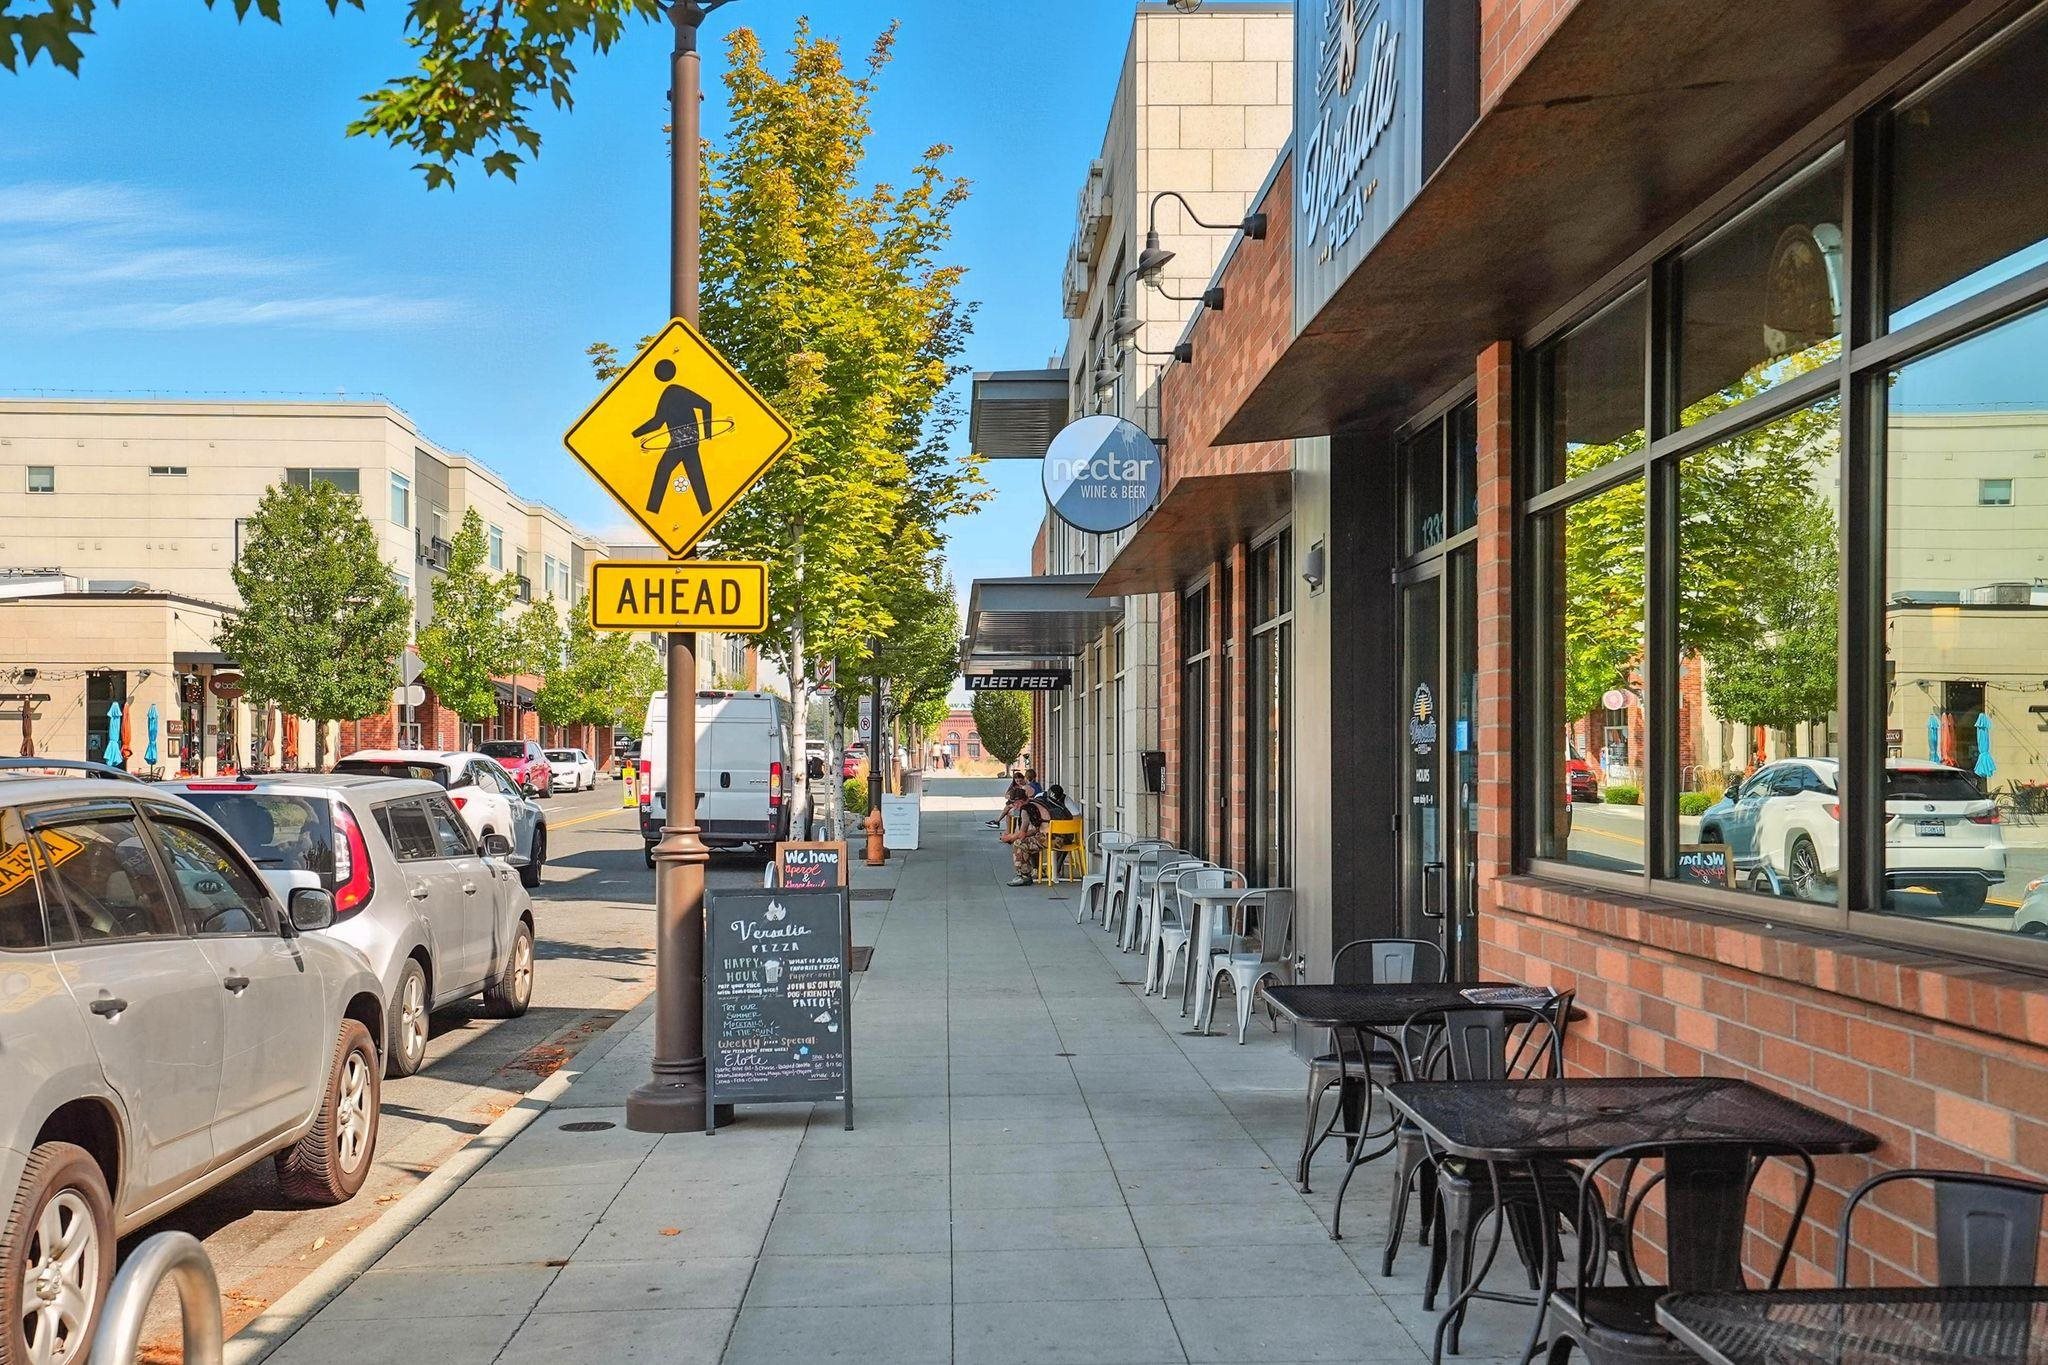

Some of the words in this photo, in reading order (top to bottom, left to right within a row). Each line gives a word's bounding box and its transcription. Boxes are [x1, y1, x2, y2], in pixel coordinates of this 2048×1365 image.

[1328, 186, 1365, 262] PIZZA
[1052, 452, 1154, 481] nectar
[1081, 485, 1107, 499] WINE
[1110, 487, 1118, 499] &
[1122, 485, 1146, 499] BEER
[1422, 510, 1444, 549] 133
[616, 578, 741, 615] AHEAD
[971, 677, 1018, 688] FLEET
[1020, 676, 1058, 688] FEET
[785, 850, 808, 864] We
[809, 850, 838, 864] have
[802, 873, 811, 883] &
[198, 882, 217, 890] KIA
[731, 920, 811, 941] Versalia
[752, 942, 799, 953] PIZZA
[724, 958, 759, 970] HAPPY
[726, 970, 758, 982] HOUR
[787, 982, 805, 990] JOIN
[807, 981, 816, 989] US
[817, 981, 828, 989] ON
[829, 980, 842, 988] OUR
[721, 1003, 735, 1011] TRY
[740, 1003, 758, 1011] OUR
[737, 1029, 751, 1037] THE
[724, 1053, 768, 1067] Elote
